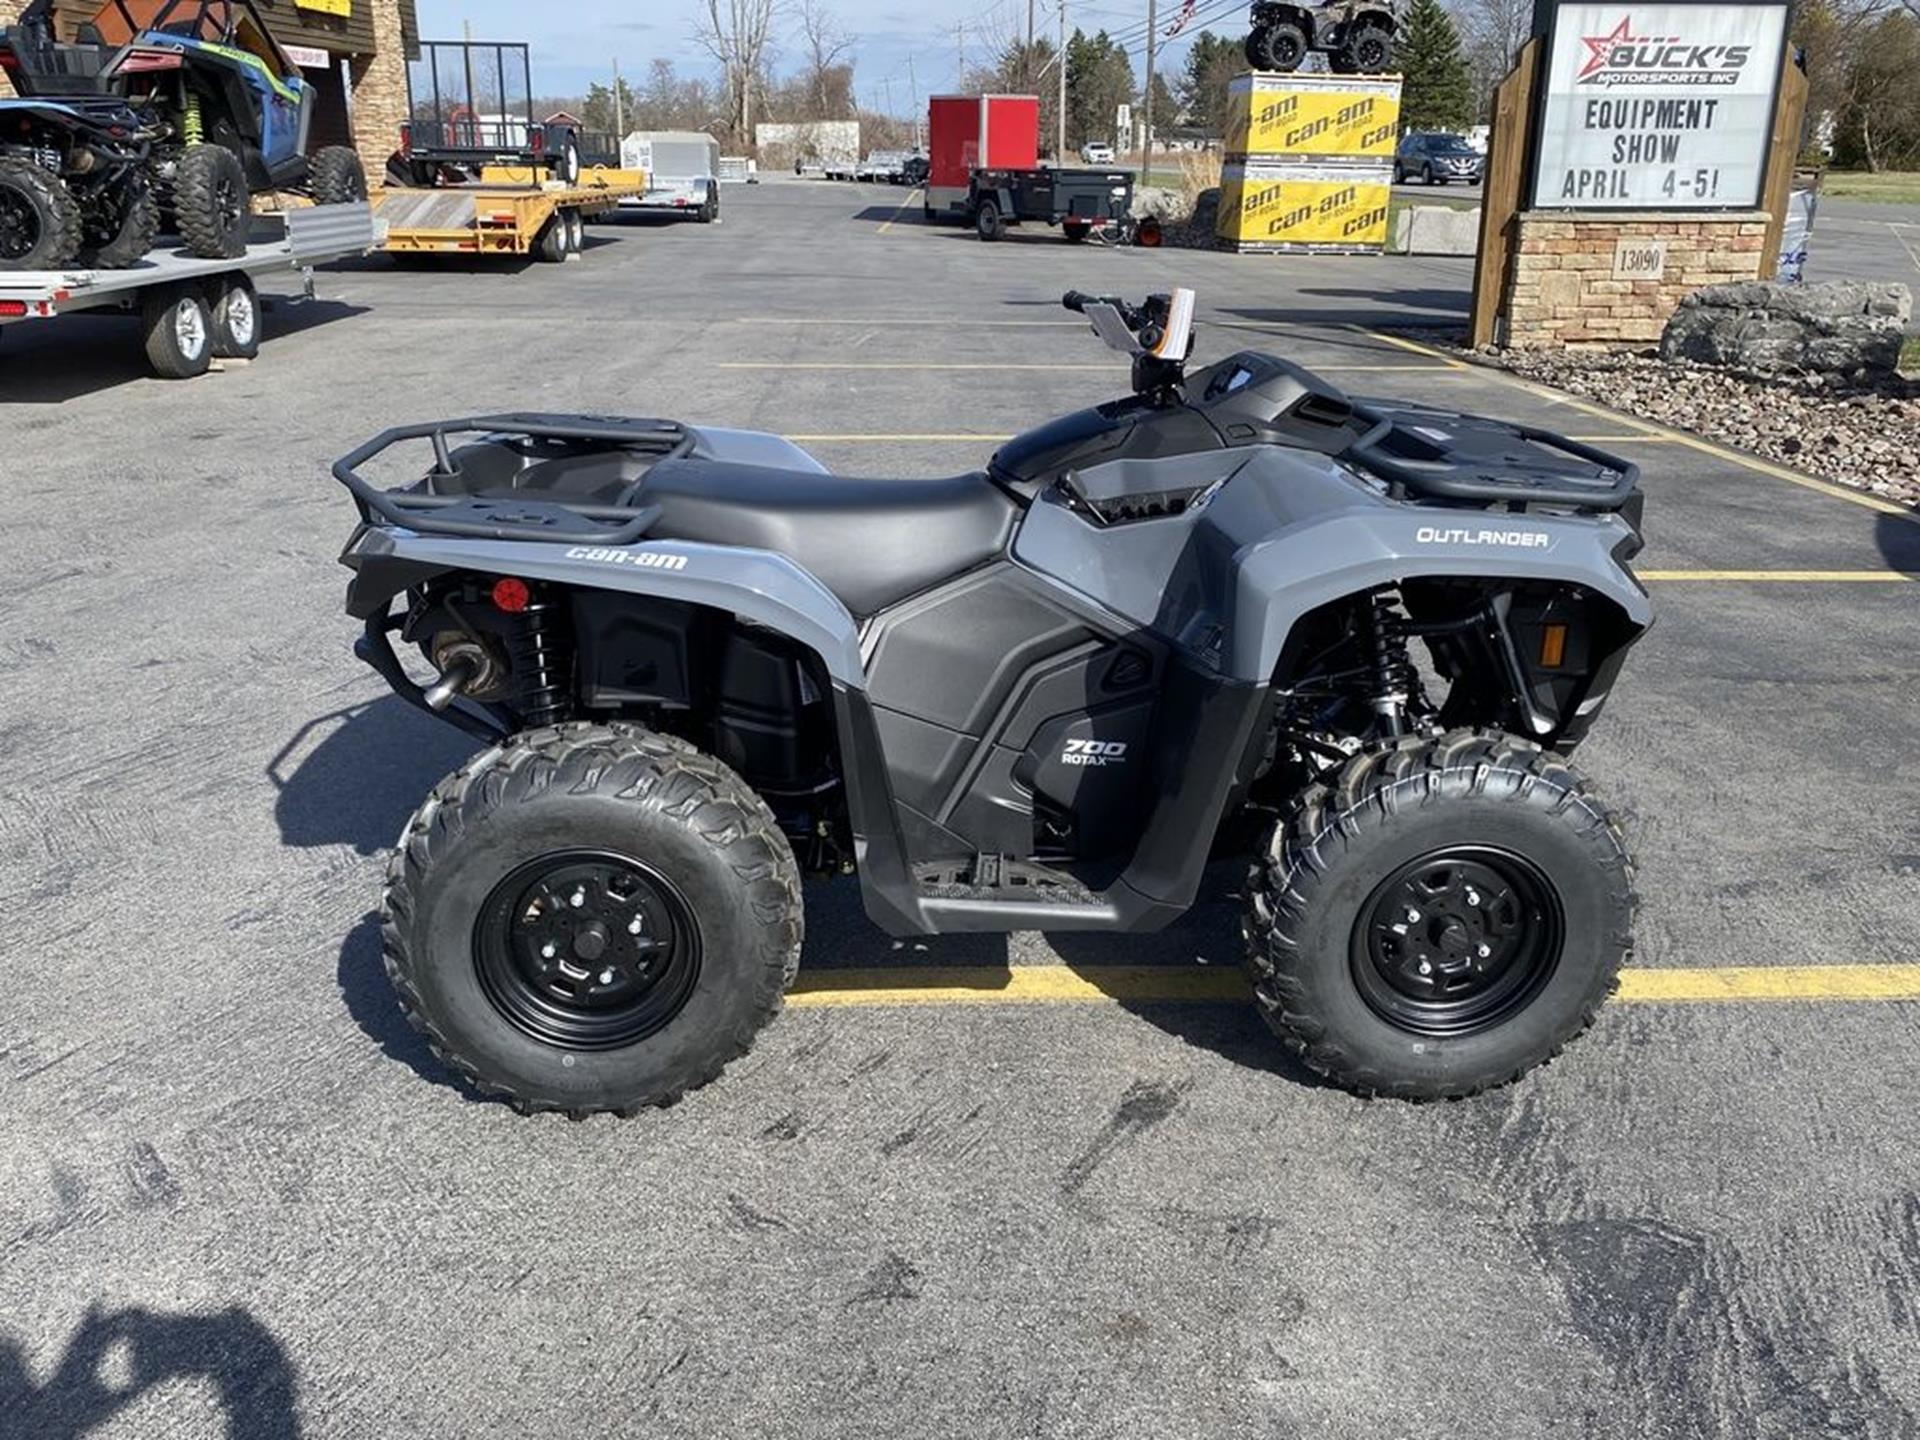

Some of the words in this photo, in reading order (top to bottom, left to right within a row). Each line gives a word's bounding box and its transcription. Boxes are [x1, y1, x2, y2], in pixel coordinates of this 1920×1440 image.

[1607, 45, 1752, 68] BUCK'S
[1597, 72, 1708, 85] MOTORSPORTS
[1710, 72, 1736, 85] INC
[1285, 97, 1374, 147] can-am
[1585, 100, 1718, 130] EQUIPMENT
[1612, 134, 1681, 164] SHOW
[1562, 170, 1630, 199] APRIL
[1662, 169, 1720, 198] 4-5!
[1268, 186, 1356, 235] can-am
[1621, 249, 1660, 271] 13090
[1416, 527, 1549, 547] OUTLANDER
[565, 547, 688, 570] can-am
[1063, 738, 1127, 756] 700
[1061, 753, 1107, 766] ROTAX
